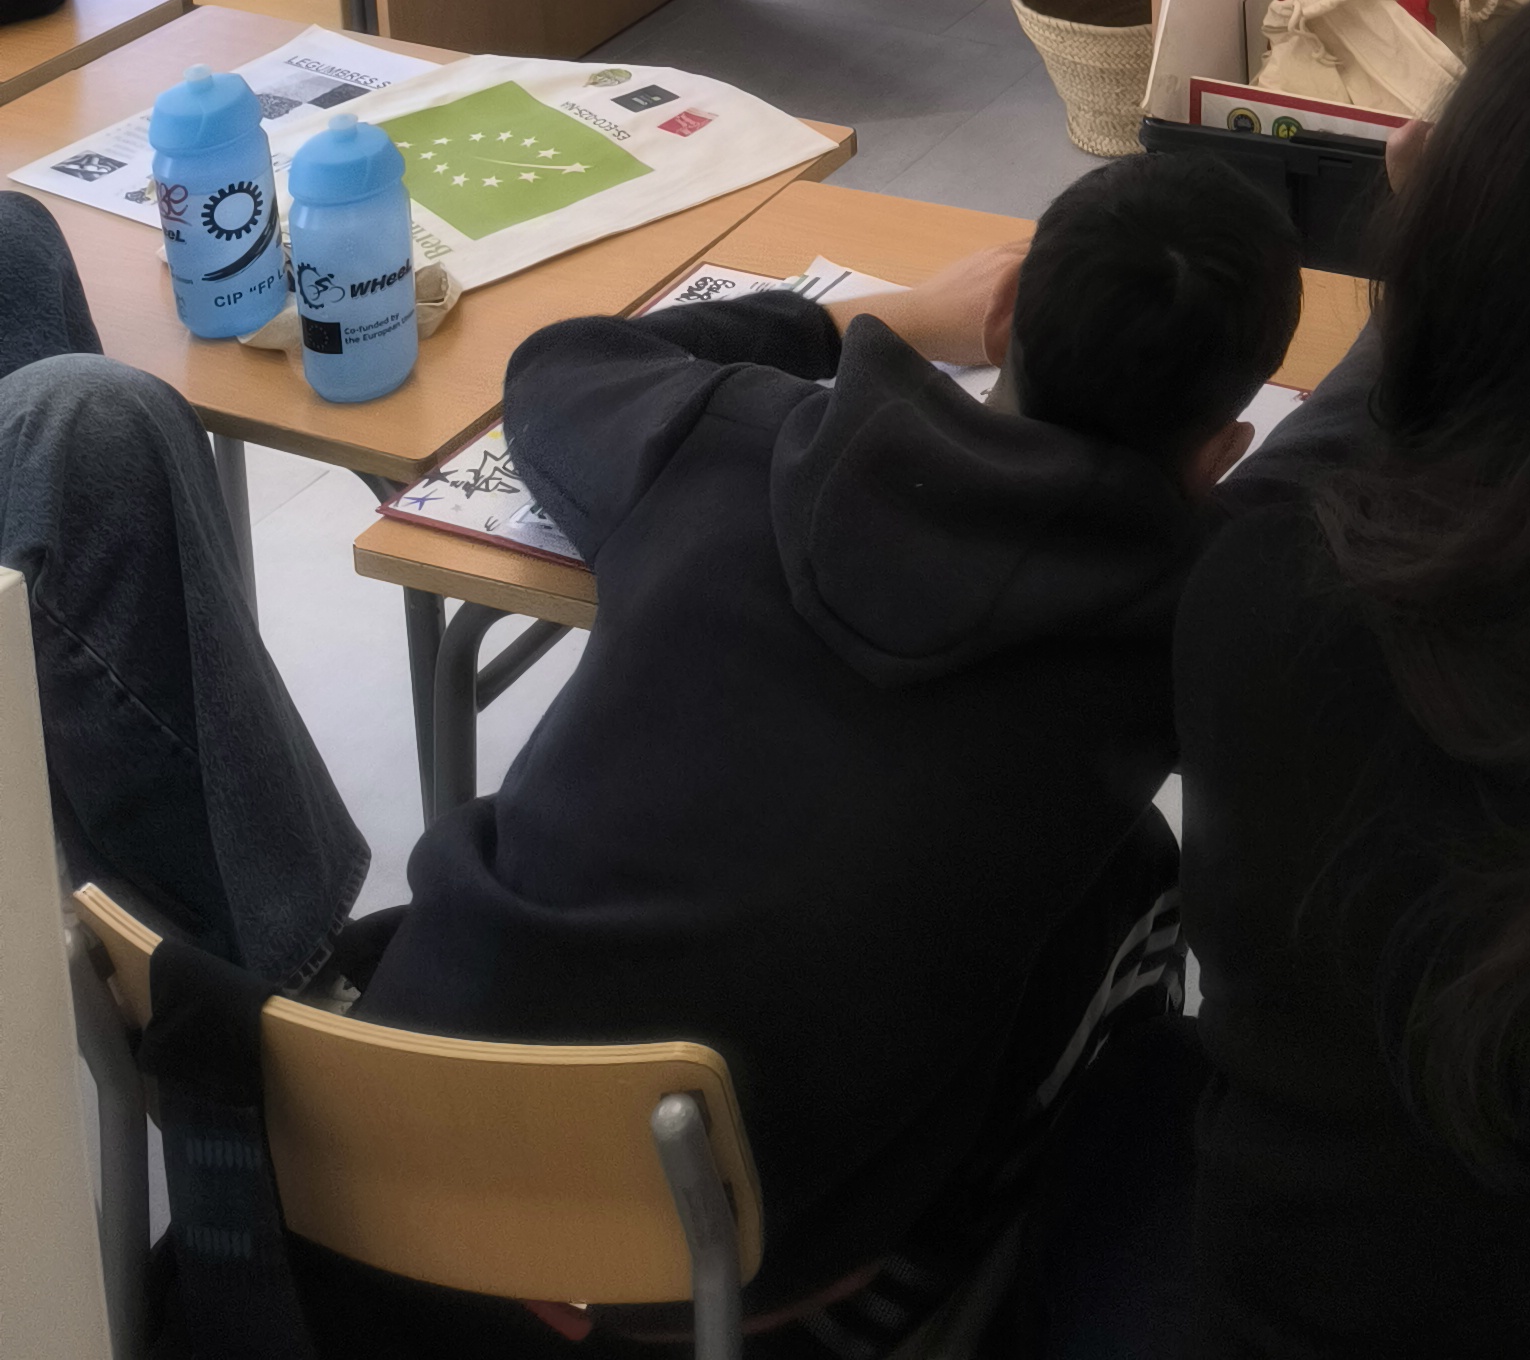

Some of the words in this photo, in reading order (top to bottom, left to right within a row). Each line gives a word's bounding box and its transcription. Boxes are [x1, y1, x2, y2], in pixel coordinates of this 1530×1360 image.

[286, 56, 379, 86] LEGUMBRES
[214, 291, 243, 308] CIP
[344, 317, 389, 335] Co-funded
[345, 336, 360, 345] the
